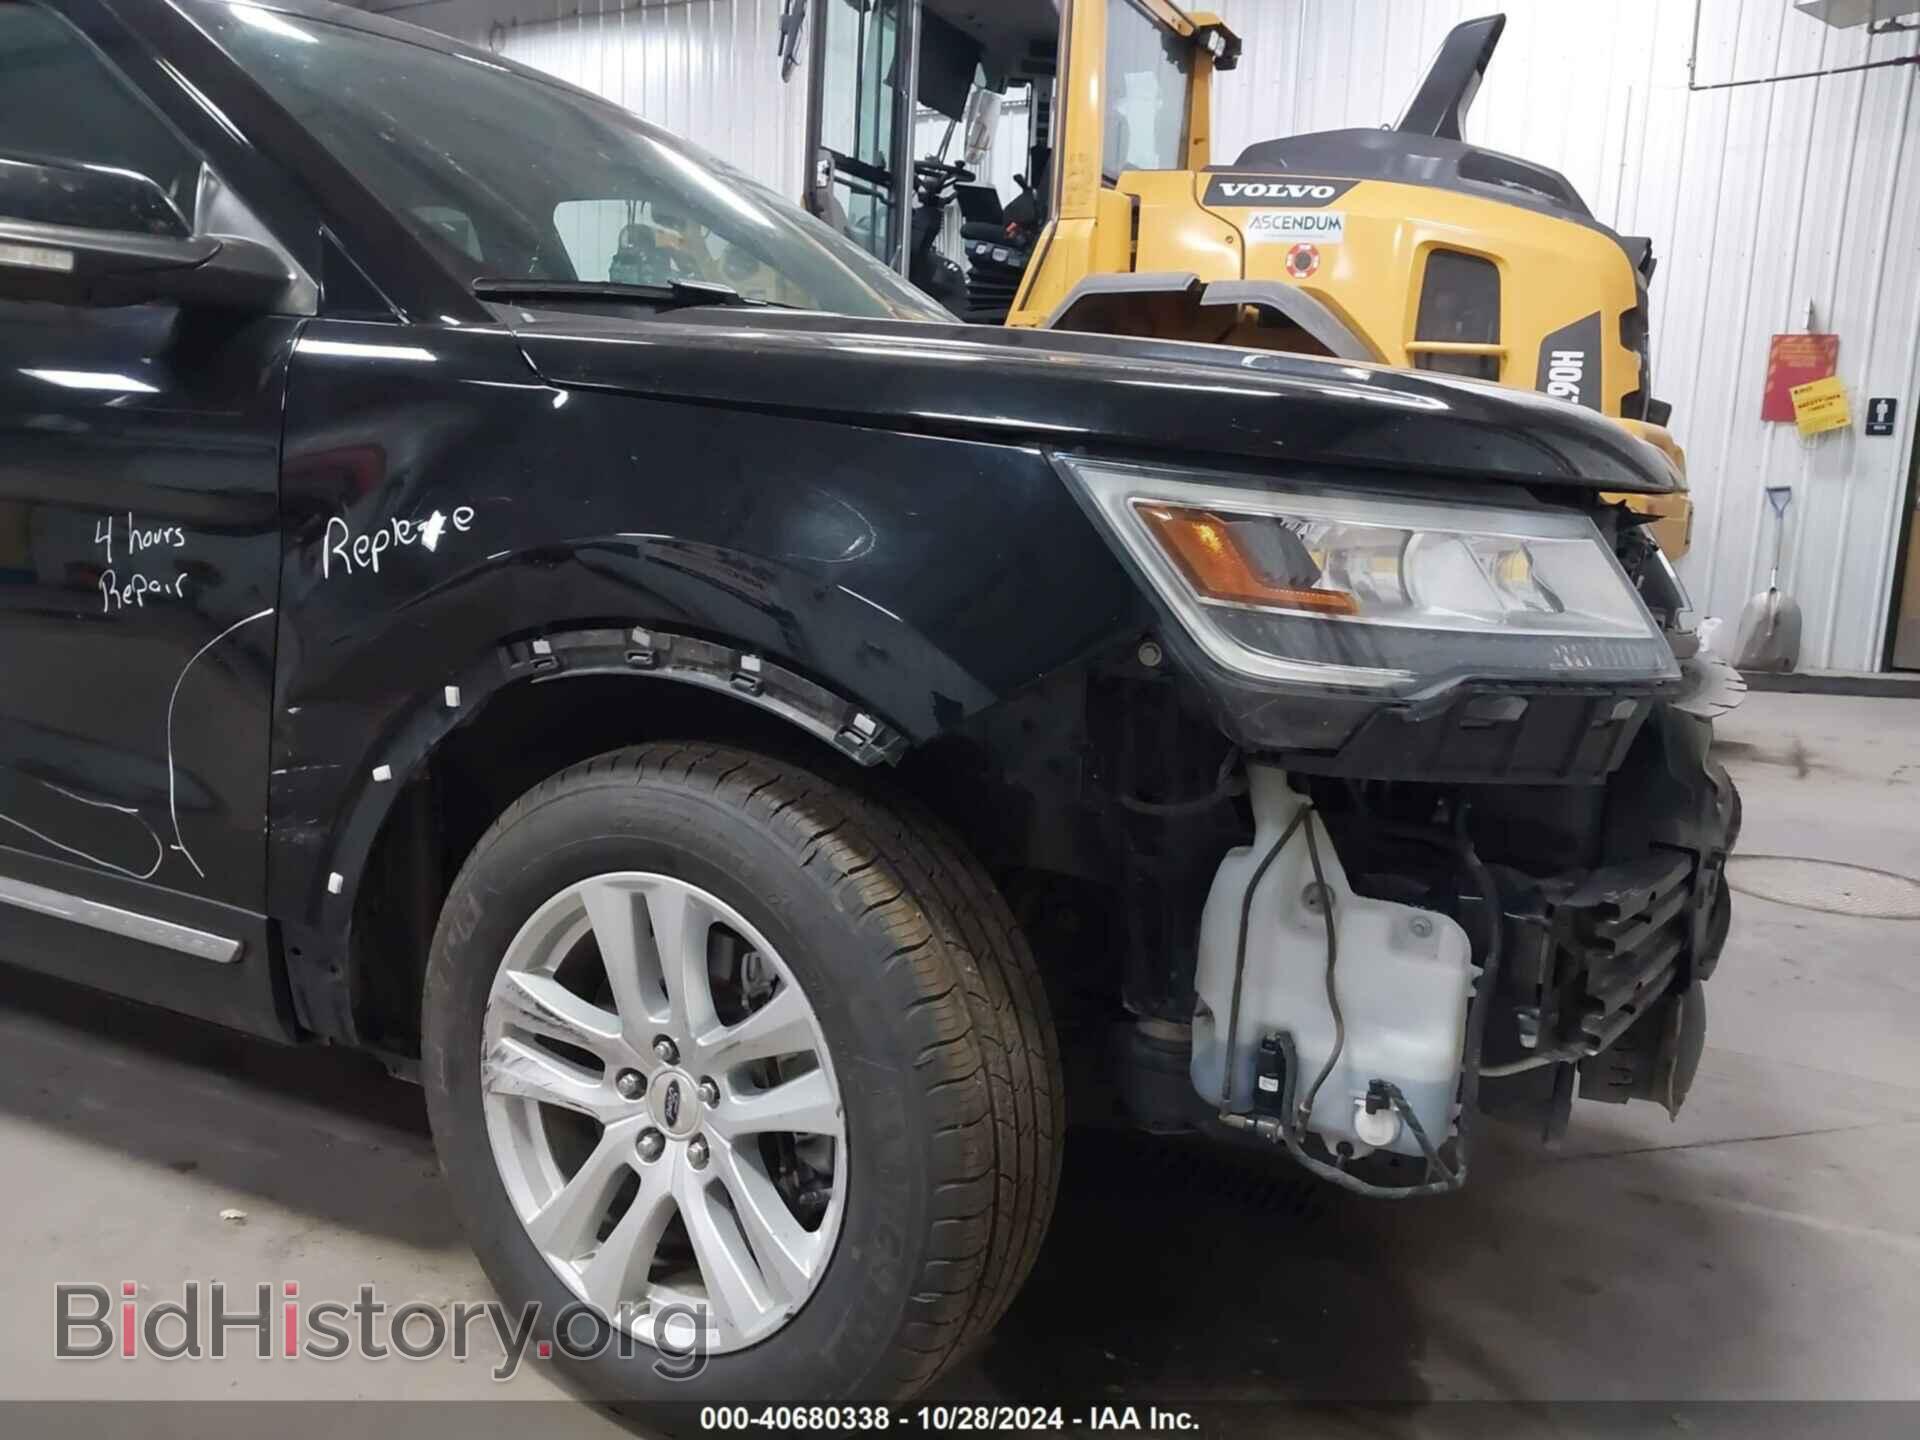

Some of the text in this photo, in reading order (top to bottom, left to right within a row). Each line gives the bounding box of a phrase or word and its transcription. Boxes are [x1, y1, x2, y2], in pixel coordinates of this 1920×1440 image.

[1218, 183, 1336, 199] VOLVO
[1249, 215, 1342, 231] ASCENDUM
[94, 511, 185, 564] 4 hours
[98, 568, 188, 613] Repair
